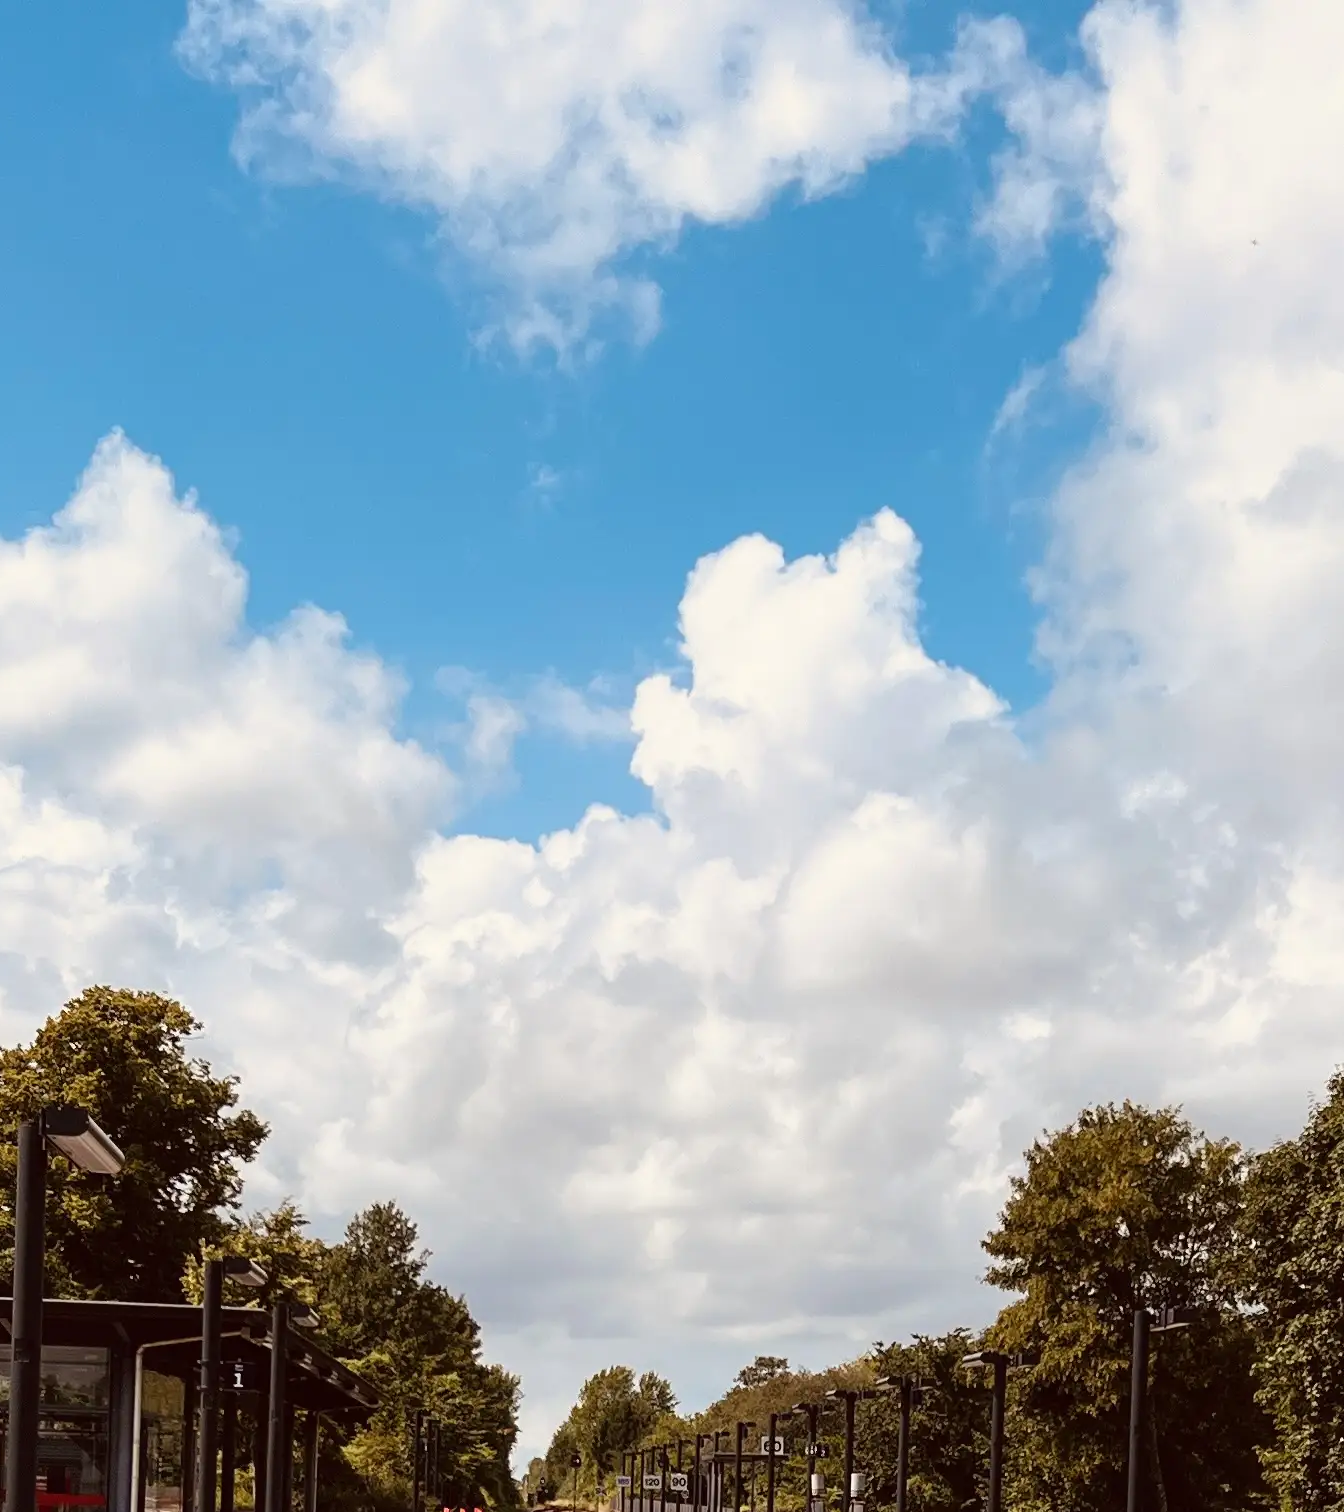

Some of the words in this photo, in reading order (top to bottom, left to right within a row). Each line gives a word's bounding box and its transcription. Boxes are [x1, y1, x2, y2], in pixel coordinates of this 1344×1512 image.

[233, 1372, 244, 1388] 1
[763, 1440, 782, 1453] 60
[645, 1478, 660, 1487] 120
[671, 1477, 686, 1487] 90
